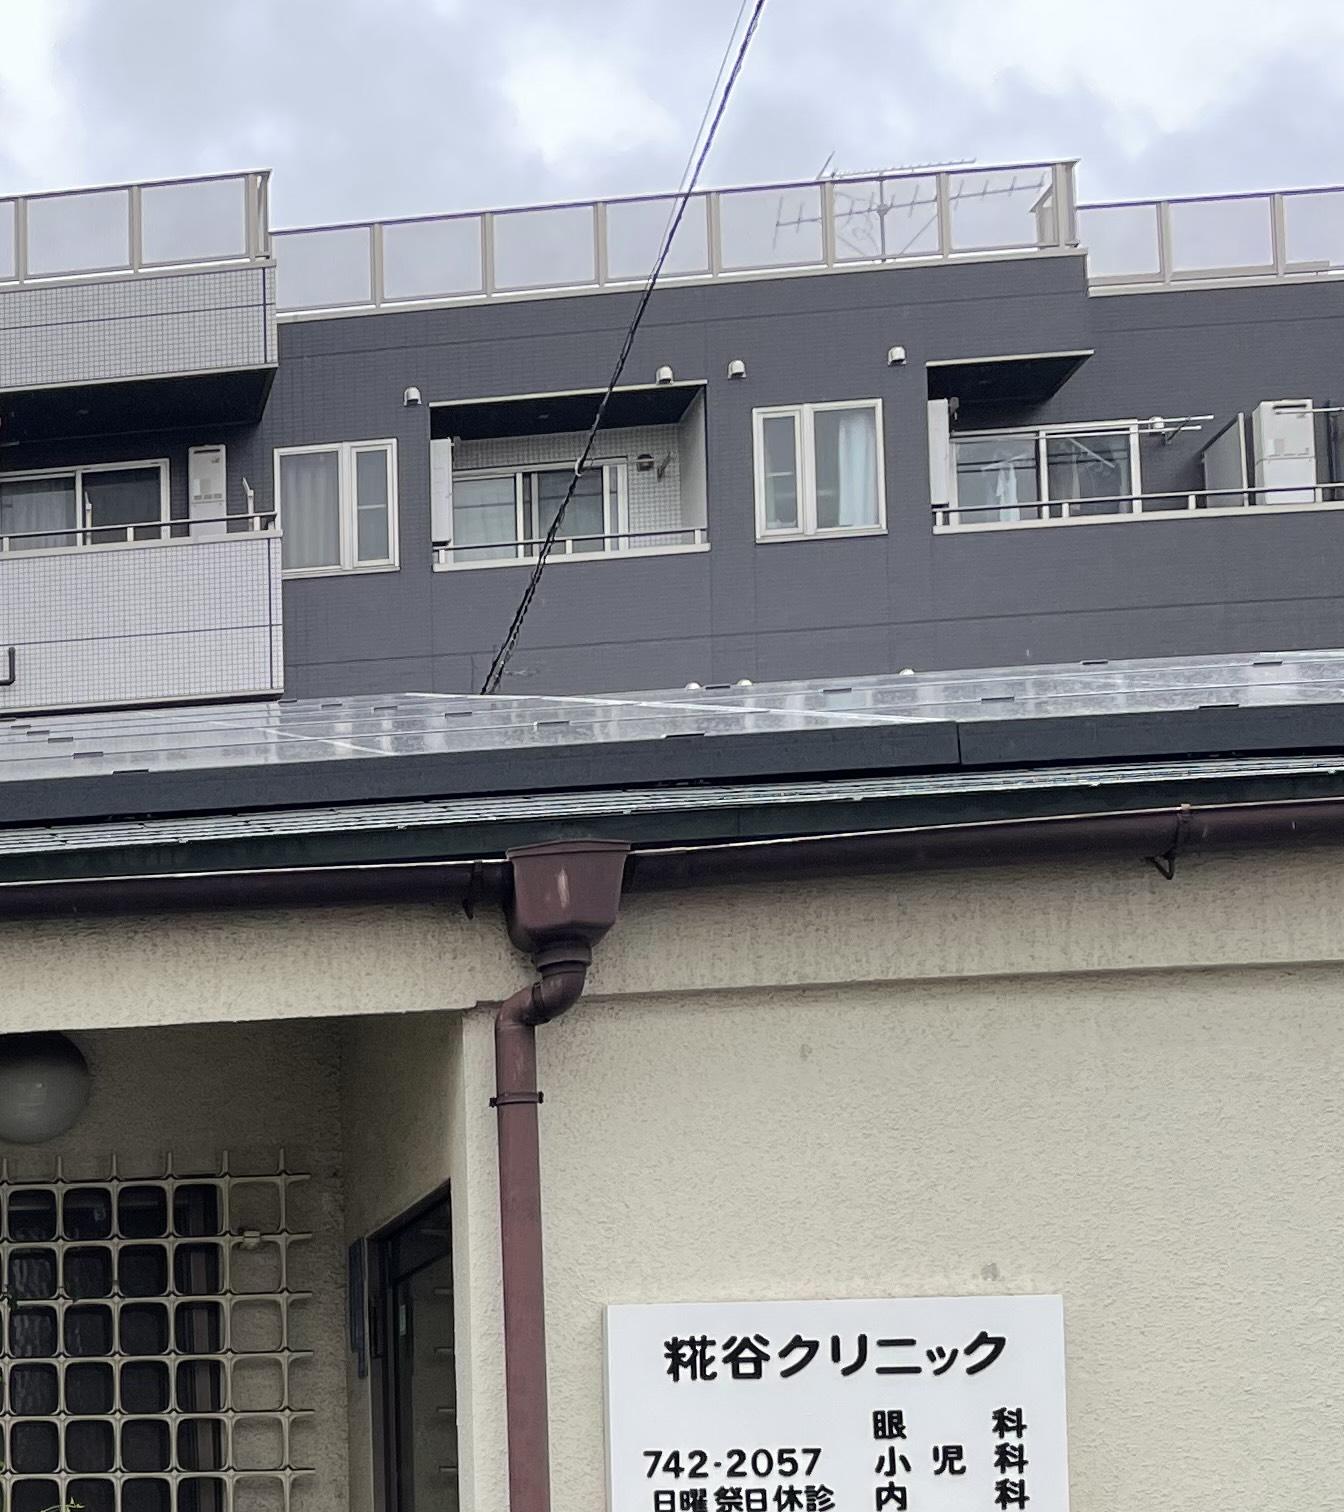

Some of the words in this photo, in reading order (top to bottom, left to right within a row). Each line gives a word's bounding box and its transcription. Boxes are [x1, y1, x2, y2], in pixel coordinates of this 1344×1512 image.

[663, 1331, 1008, 1382] 糀谷クリニック
[642, 1447, 823, 1479] 742-2057
